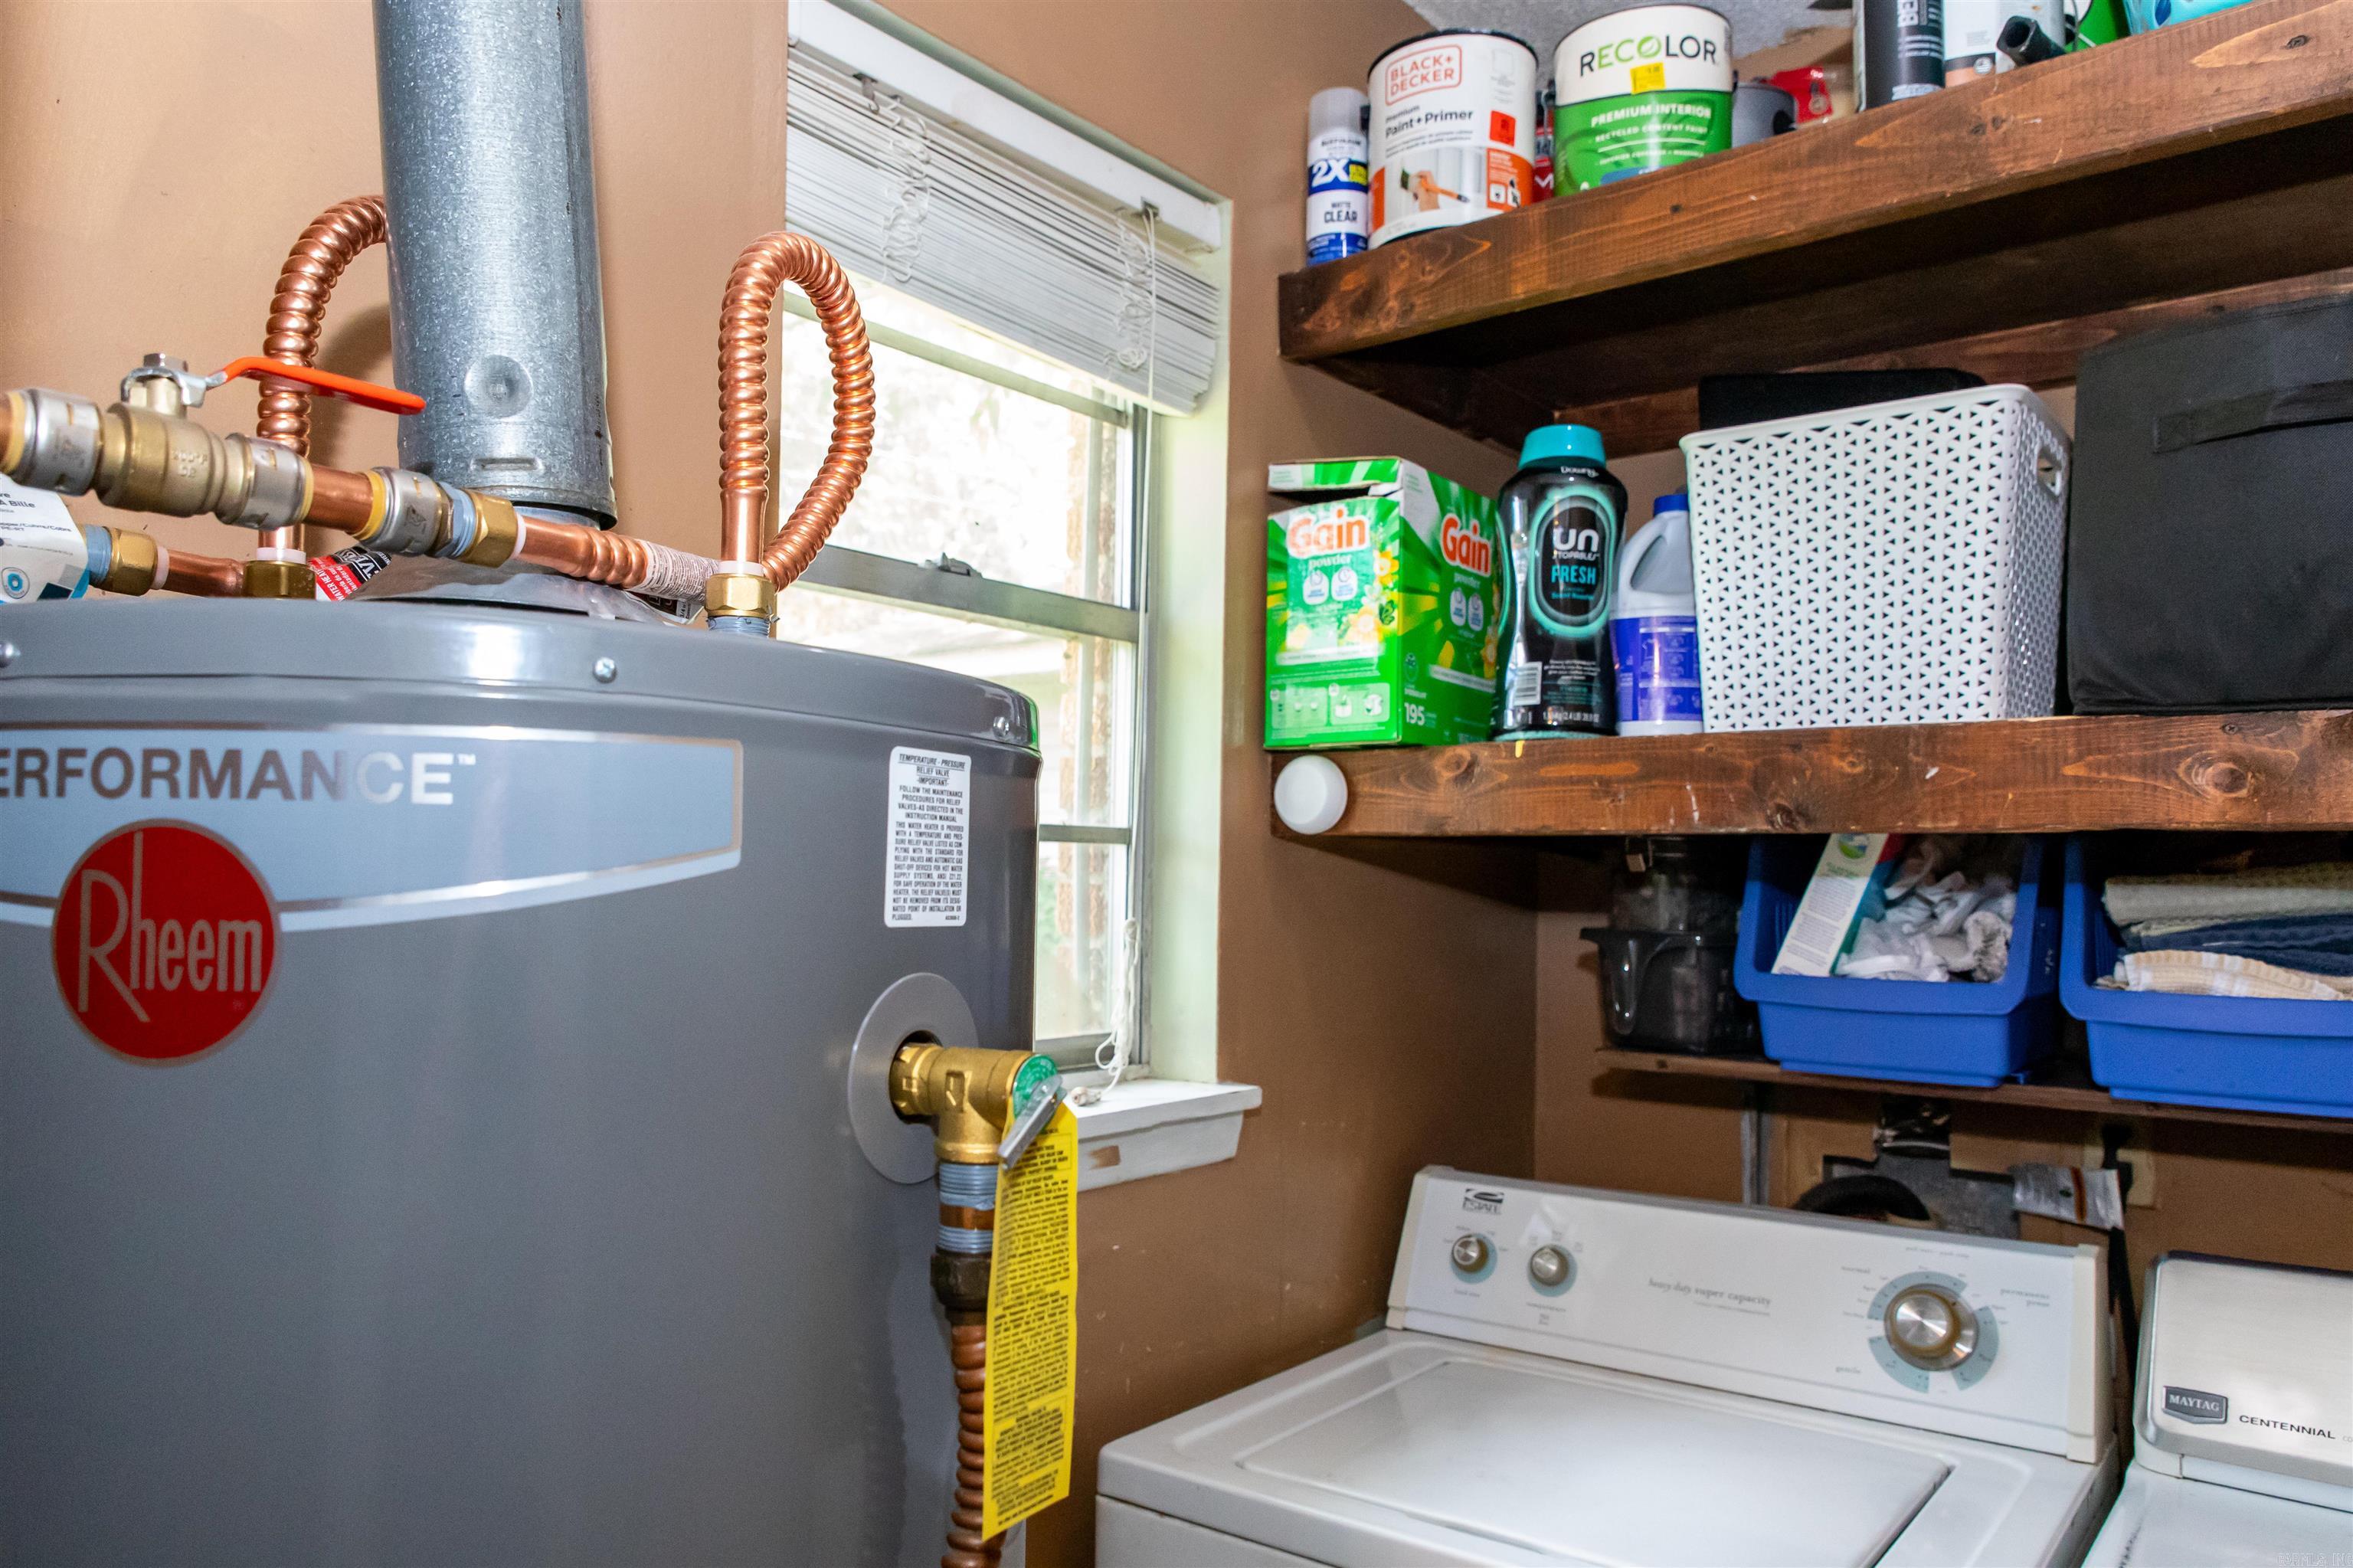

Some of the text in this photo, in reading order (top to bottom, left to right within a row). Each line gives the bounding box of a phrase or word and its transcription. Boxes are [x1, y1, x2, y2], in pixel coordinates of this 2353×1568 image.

[1580, 35, 1716, 77] RECOLOR
[1390, 68, 1455, 97] DECKER
[1386, 119, 1414, 139] Paint
[1425, 110, 1474, 125] Primer
[1591, 103, 1712, 129] PREMIUM INTERIOR
[1595, 126, 1640, 143] RECYCLED
[1312, 159, 1350, 188] 2X
[1324, 210, 1358, 224] CLEAR
[1560, 466, 1599, 478] Downy
[8, 500, 36, 509] Bille
[1288, 509, 1366, 557] Gain
[1442, 517, 1490, 574] Gain
[1551, 565, 1597, 585] FRESH
[1404, 702, 1425, 726] 195
[899, 754, 937, 765] TEMPERATURE
[941, 759, 965, 769] PRESSURE
[917, 766, 950, 777] RELIEF VALVE
[902, 794, 934, 804] PROCEDURES
[932, 788, 963, 797] MAINTENANCE
[905, 812, 957, 823] INSTRUCTION MANUAL
[78, 830, 263, 1023] Rheem
[1694, 1287, 1724, 1300] super
[1727, 1292, 1771, 1308] capacity
[2169, 1394, 2220, 1411] MAYTAG
[2239, 1414, 2336, 1439] CENTENNIAL
